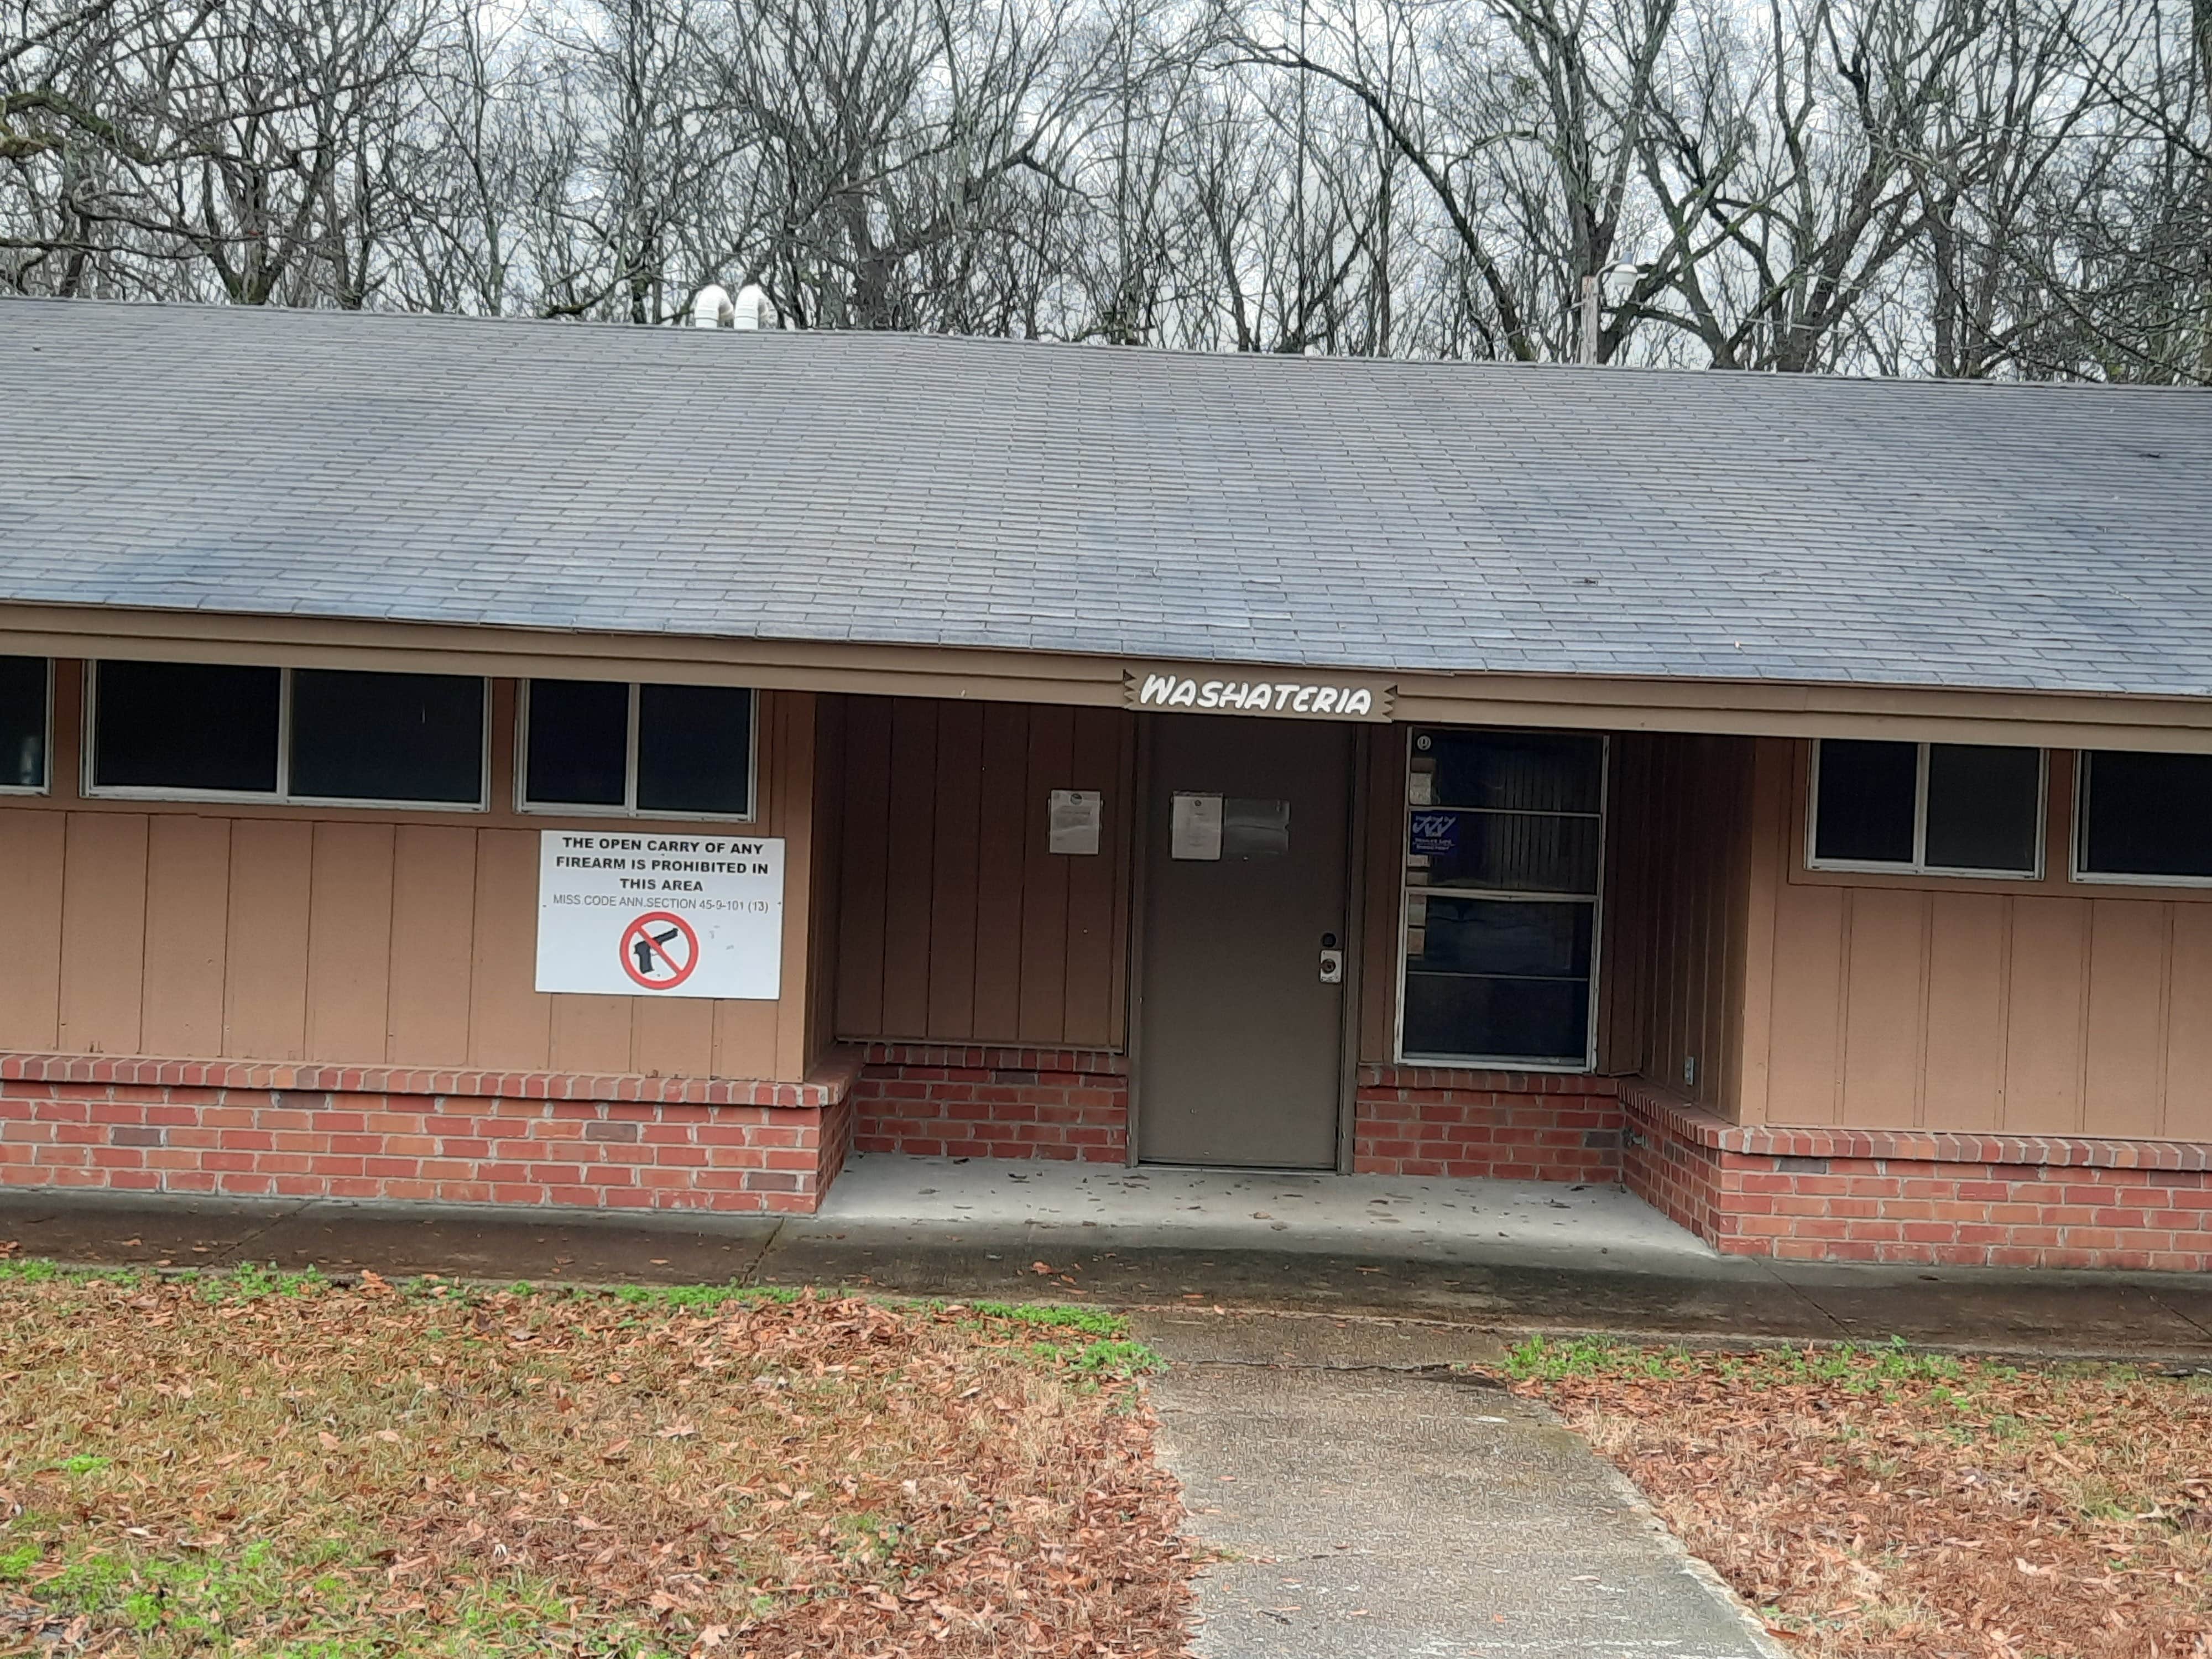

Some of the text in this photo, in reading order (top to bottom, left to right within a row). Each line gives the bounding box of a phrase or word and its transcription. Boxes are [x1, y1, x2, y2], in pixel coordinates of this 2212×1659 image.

[1140, 674, 1372, 715] WASHATERIA
[562, 837, 764, 854] THE OPEN CARRY OF ANY
[556, 856, 769, 874] FIREARM IS PROHIBITED IN
[620, 878, 703, 891] THIS AREA
[748, 901, 769, 913] (13)
